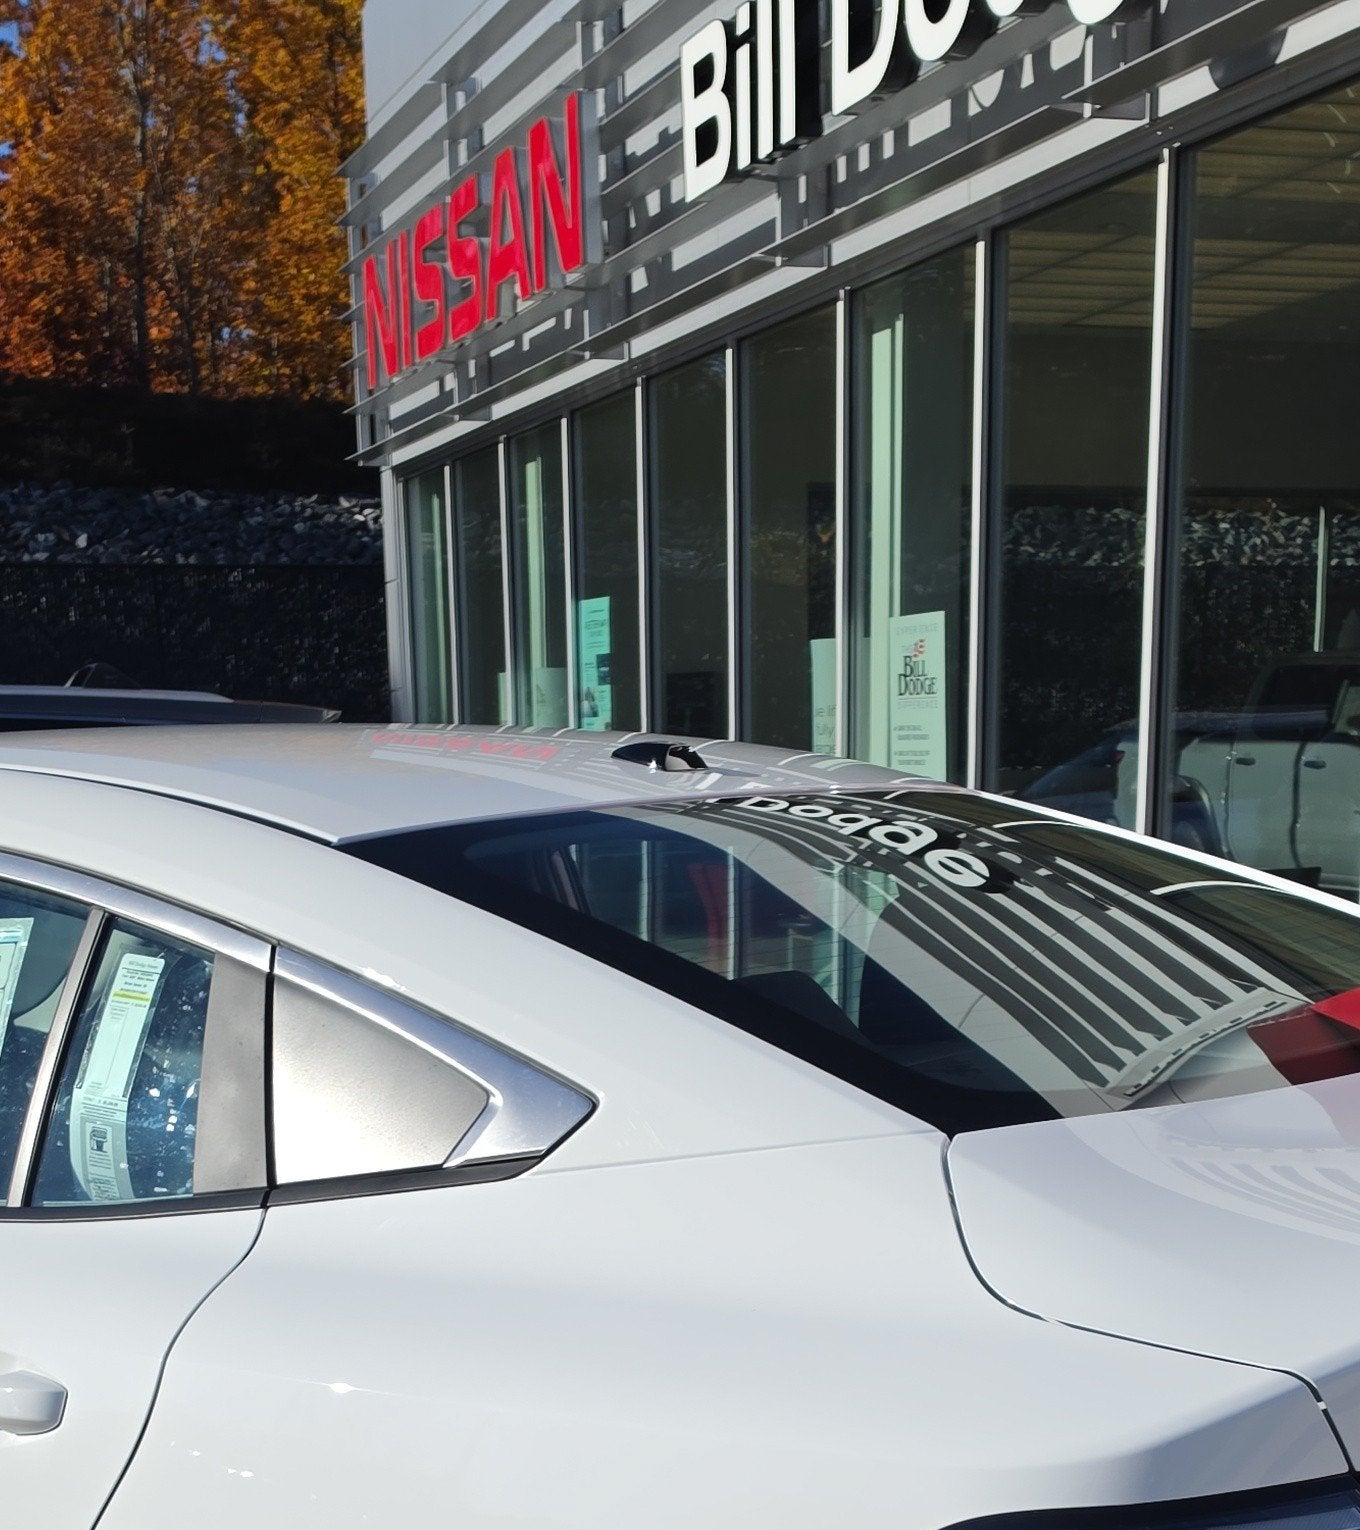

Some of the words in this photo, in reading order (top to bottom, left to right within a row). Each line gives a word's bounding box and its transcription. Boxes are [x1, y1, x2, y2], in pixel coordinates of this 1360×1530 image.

[681, 0, 795, 202] Bill
[363, 91, 583, 390] NISSAN
[897, 674, 937, 696] DODGE
[903, 655, 927, 677] BILL
